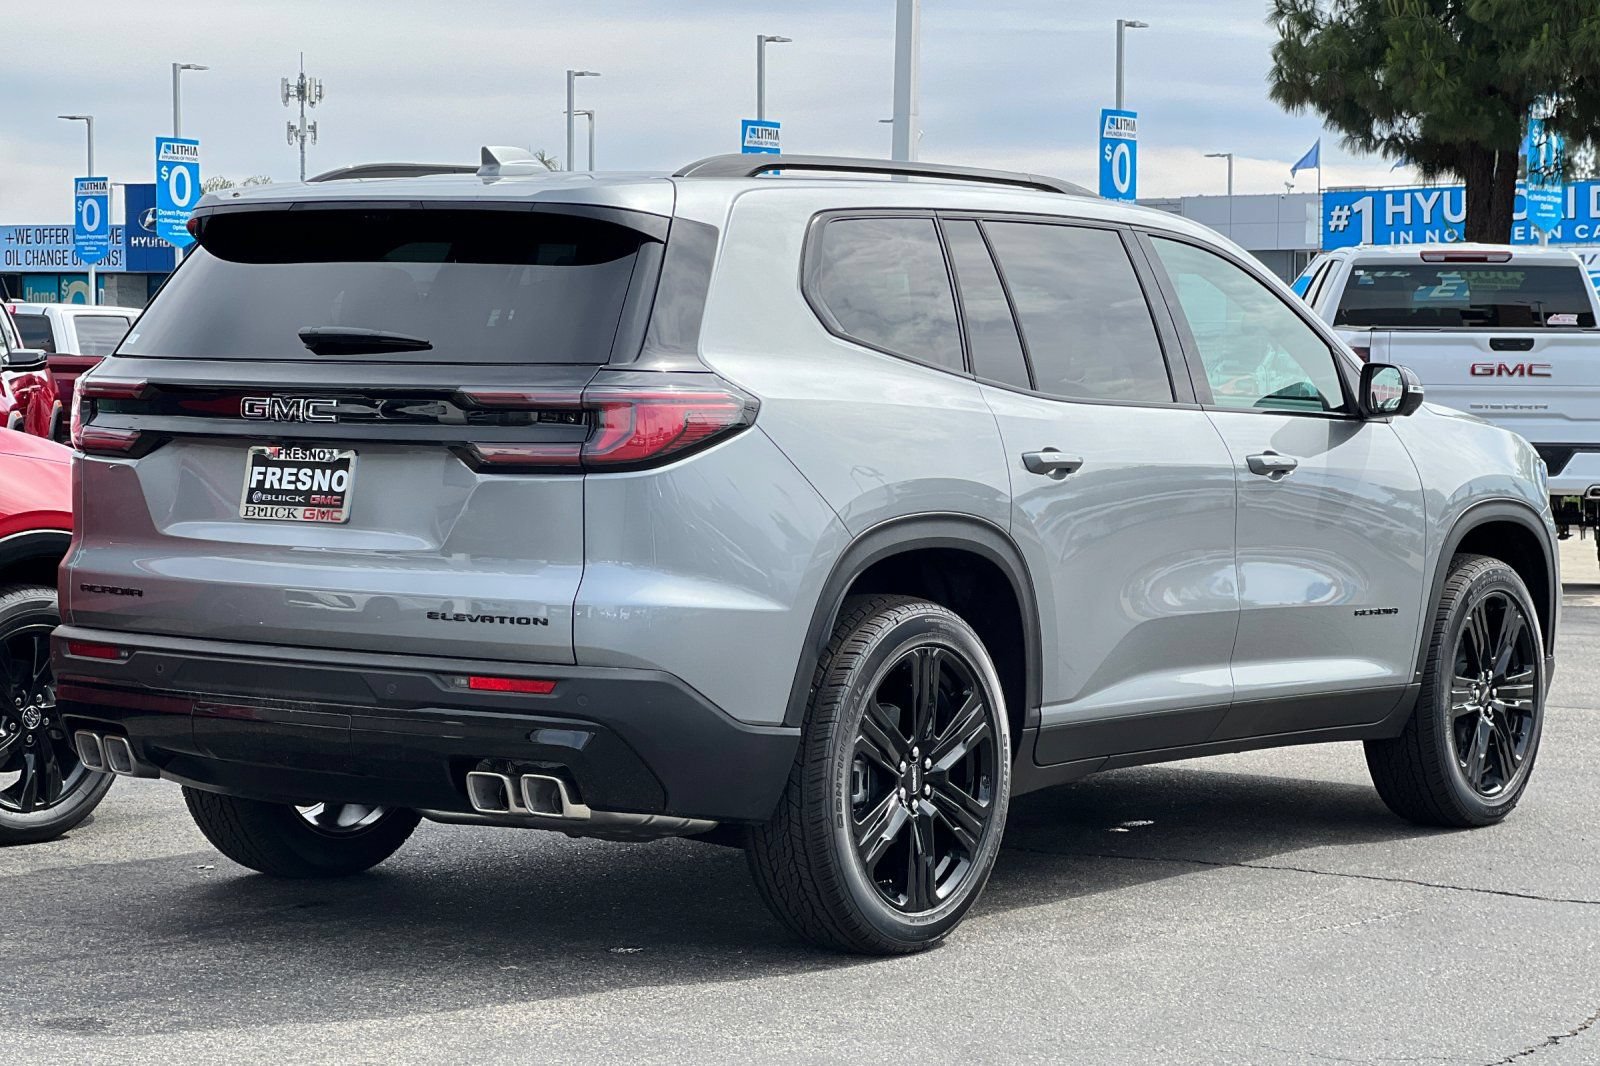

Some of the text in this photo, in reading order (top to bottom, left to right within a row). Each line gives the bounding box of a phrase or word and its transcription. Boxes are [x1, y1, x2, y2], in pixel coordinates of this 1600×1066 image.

[1116, 118, 1136, 131] LITHIA
[757, 128, 779, 140] LITHIA
[172, 144, 198, 156] LITHIA
[1104, 142, 1131, 194] $0
[160, 165, 192, 208] $0
[77, 198, 101, 232] $0
[1328, 196, 1373, 244] #1
[35, 228, 69, 245] OFFER
[1391, 231, 1413, 244] IN
[5, 250, 22, 266] OIL
[25, 250, 69, 266] CHANGE
[1470, 363, 1552, 377] GMC
[240, 396, 339, 423] GMC
[277, 448, 326, 461] FRESNO
[250, 466, 349, 493] FRESNO
[261, 494, 342, 505] BUICK GMC
[243, 505, 343, 521] BUICK GMC
[80, 583, 143, 598] ACADIA
[426, 611, 549, 626] ELEVATION
